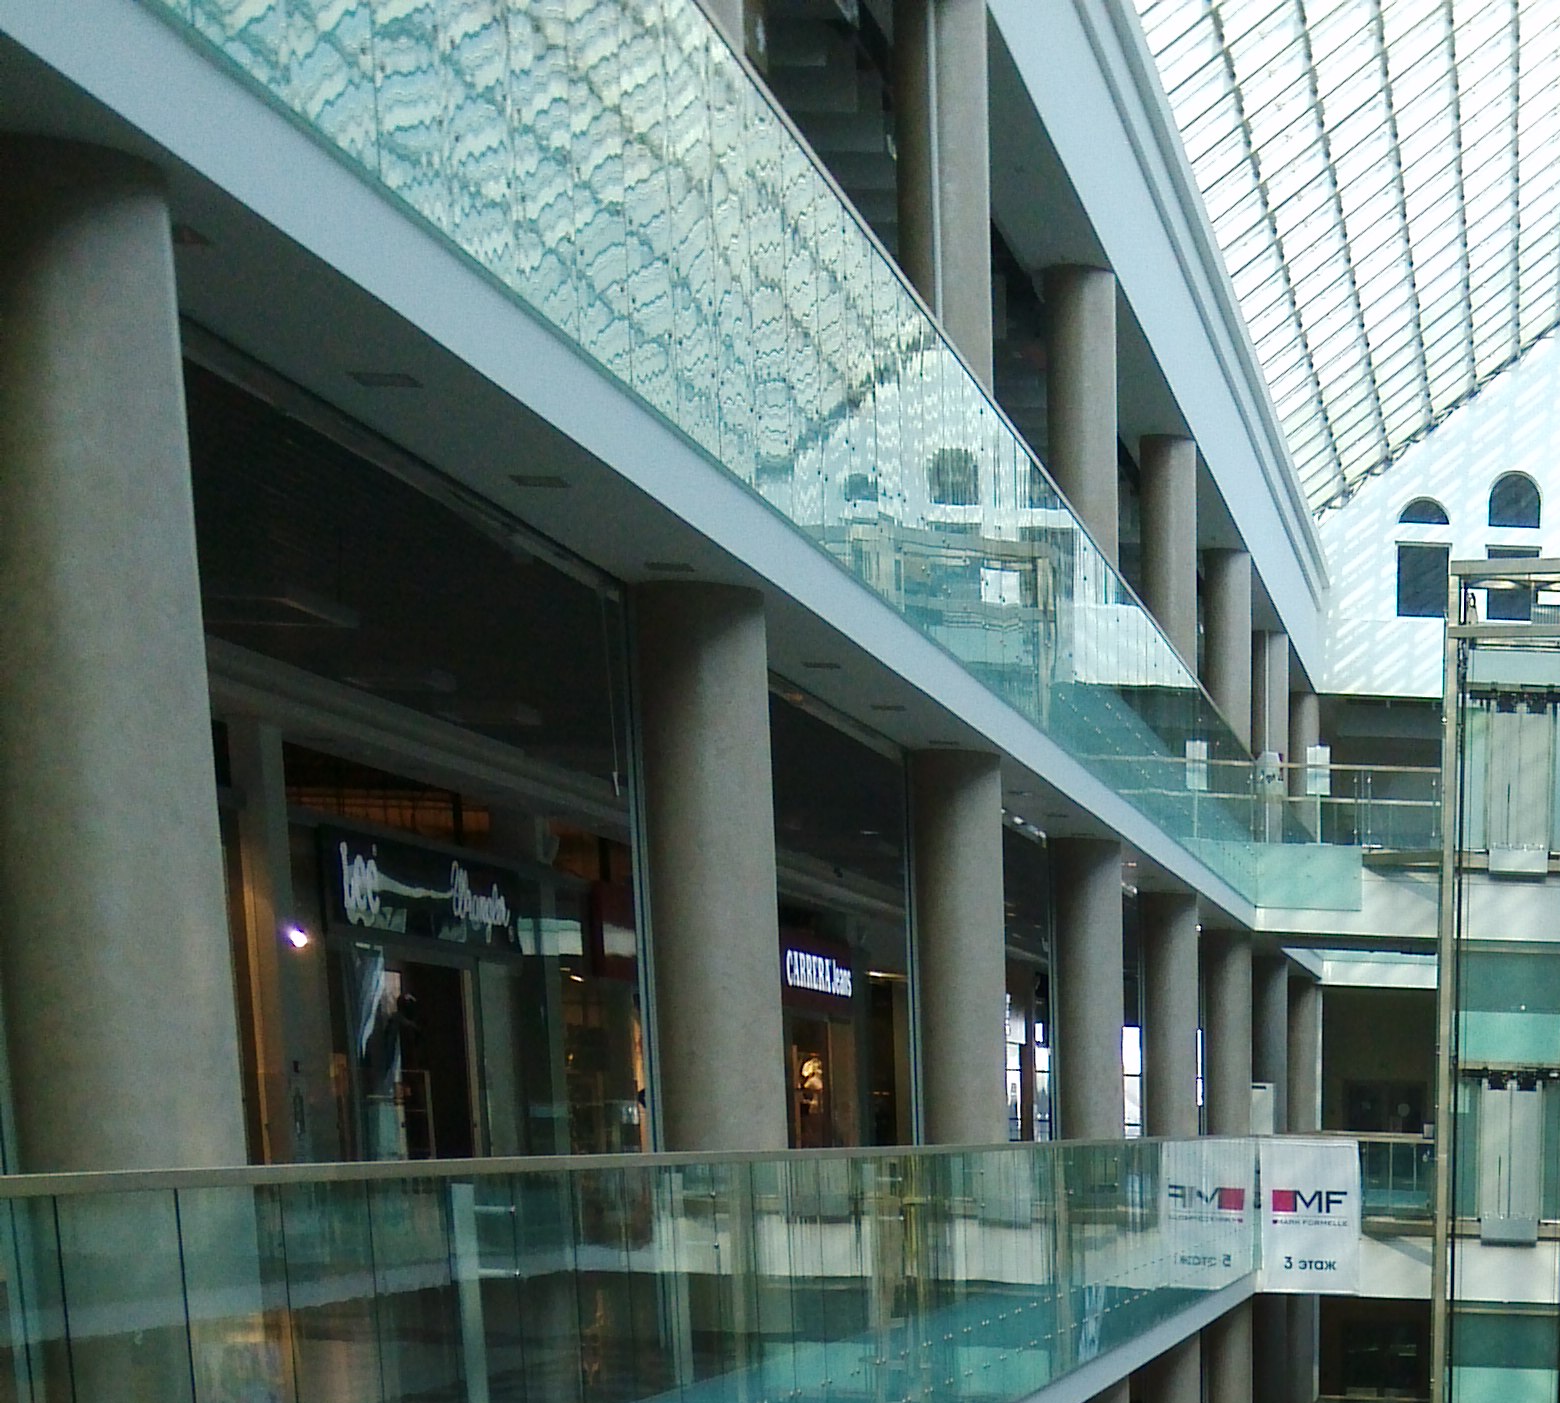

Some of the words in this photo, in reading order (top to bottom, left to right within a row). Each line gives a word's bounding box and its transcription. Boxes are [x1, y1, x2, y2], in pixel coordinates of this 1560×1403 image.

[340, 841, 380, 918] Lee
[451, 860, 511, 944] Wrangler
[786, 949, 831, 994] CARRERA
[831, 959, 853, 998] Jeans
[1294, 1190, 1348, 1213] MF
[1303, 1219, 1348, 1228] FORMELLE
[1284, 1256, 1293, 1270] 3
[1298, 1259, 1336, 1271] этаж
